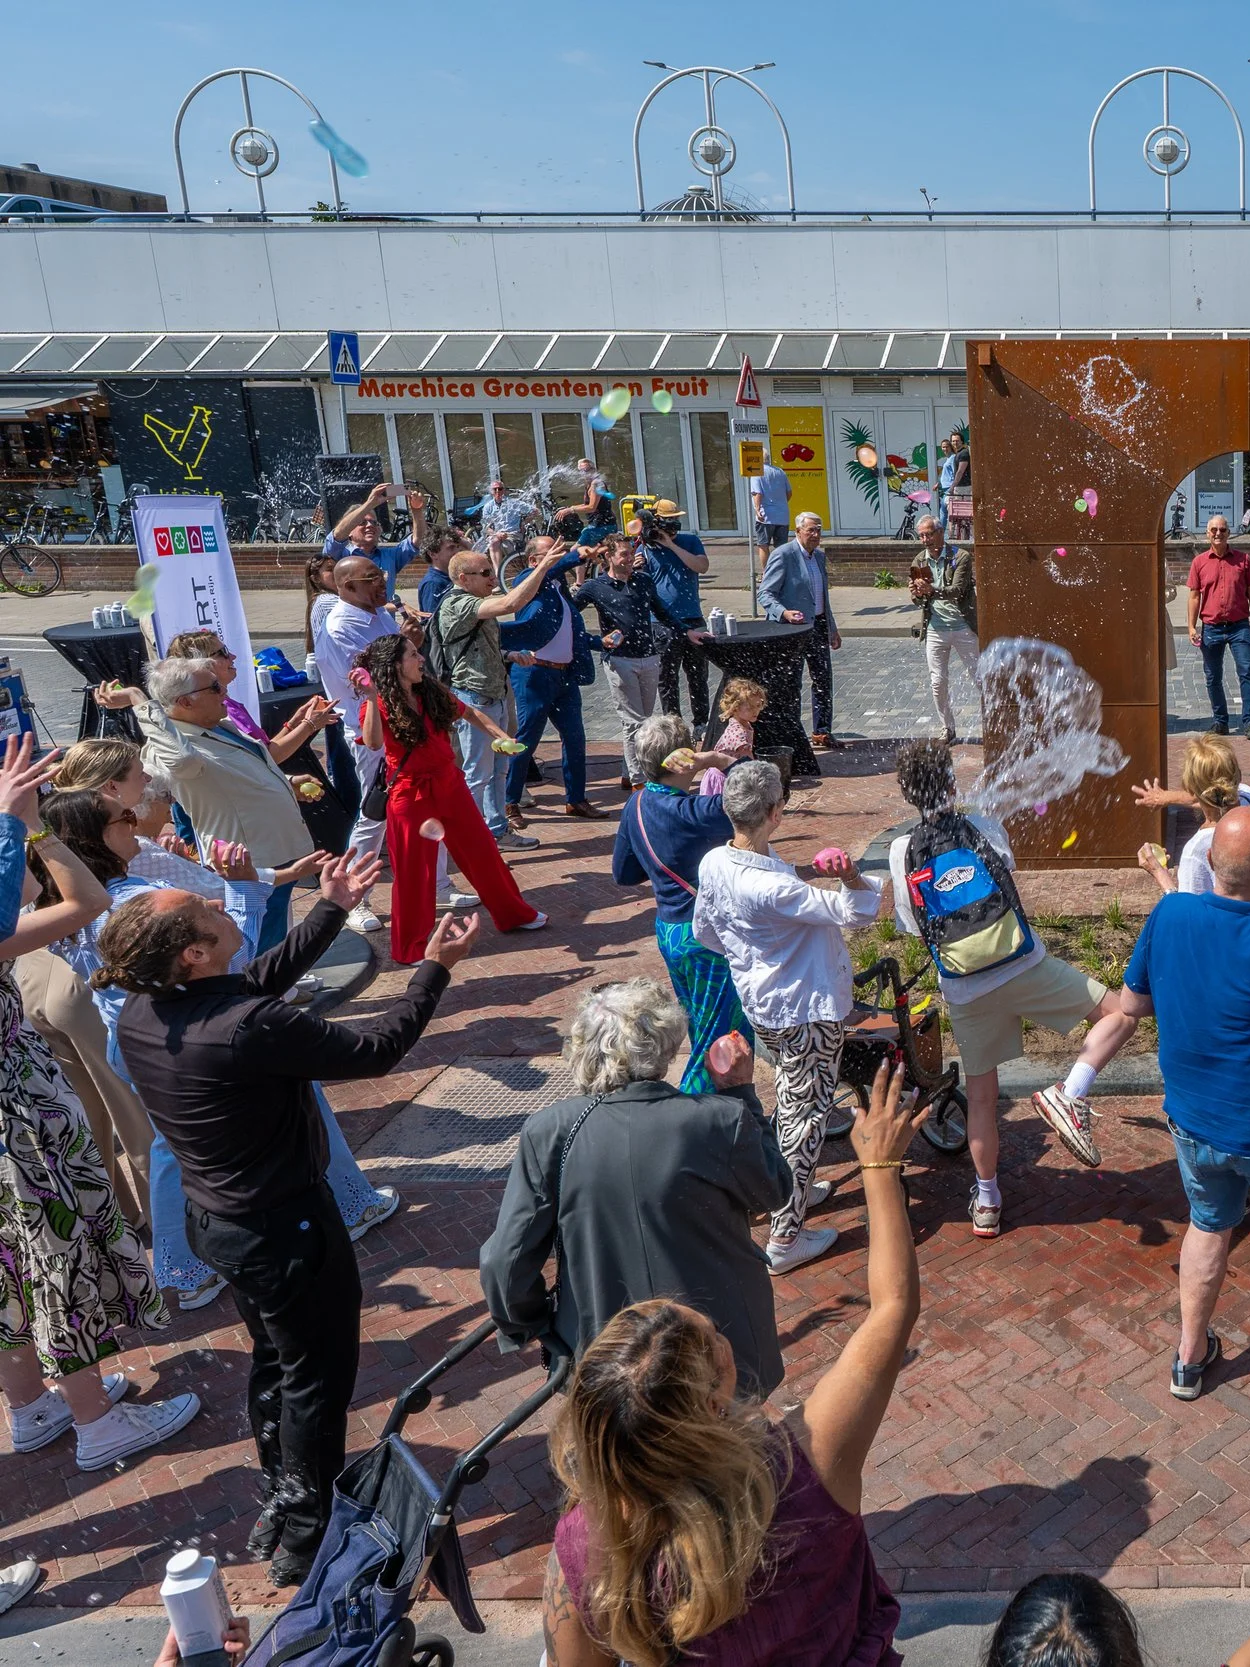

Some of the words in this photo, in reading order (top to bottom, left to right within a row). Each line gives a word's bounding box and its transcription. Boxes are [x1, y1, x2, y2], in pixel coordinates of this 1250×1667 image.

[358, 376, 475, 398] Marchica
[483, 378, 603, 398] Groenten
[651, 376, 709, 397] Fruit
[735, 423, 769, 434] BOUWVERKEER
